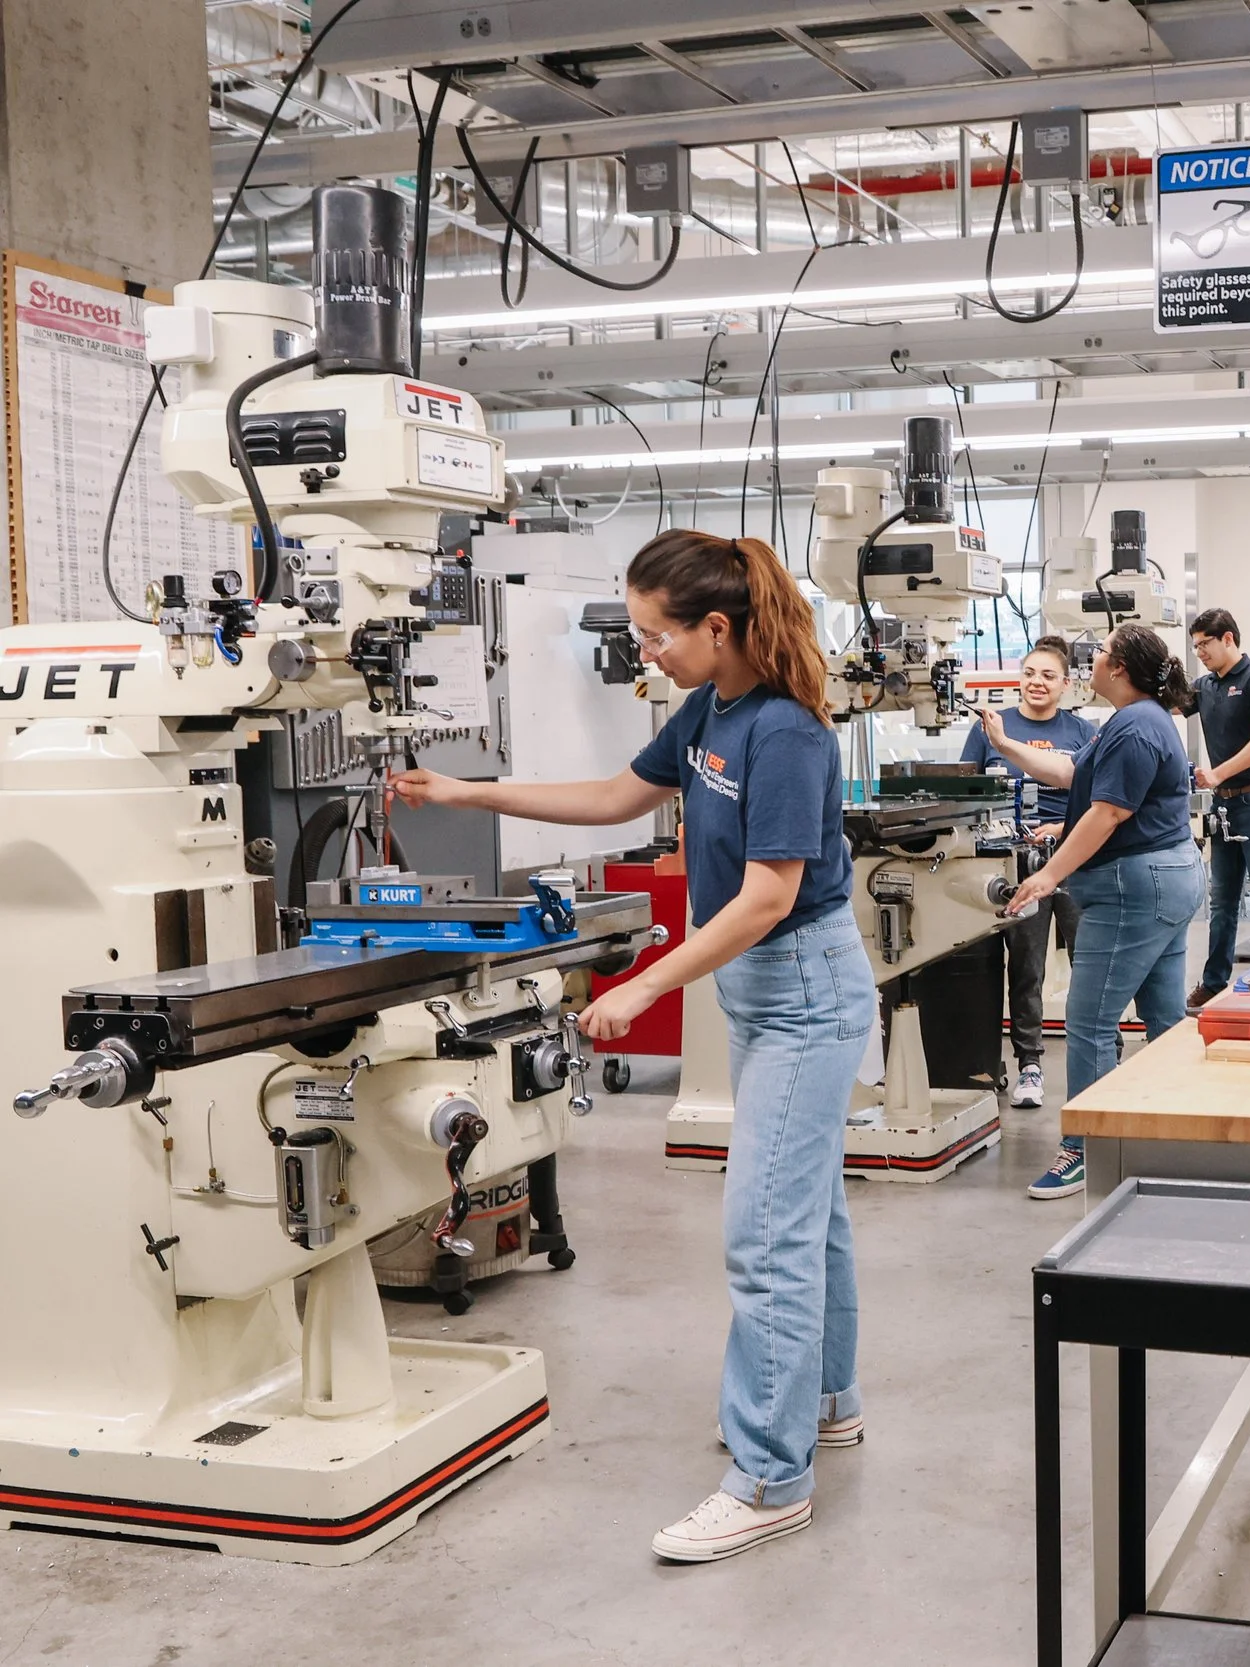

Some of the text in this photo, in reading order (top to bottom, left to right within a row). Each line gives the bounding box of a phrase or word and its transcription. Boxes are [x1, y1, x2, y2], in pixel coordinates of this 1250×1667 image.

[1162, 275, 1203, 290] Safety
[29, 280, 122, 327] Starrett
[330, 293, 354, 302] Power
[1162, 288, 1218, 305] required
[1162, 302, 1228, 319] this point.
[86, 338, 101, 351] TAP
[102, 342, 123, 357] DRILL
[124, 347, 144, 361] SIZES
[407, 395, 463, 424] JET
[962, 533, 984, 551] JET
[0, 663, 136, 700] JET
[965, 688, 1022, 704] JET
[201, 797, 226, 822] M
[380, 888, 417, 902] KURT
[469, 1175, 529, 1212] RIDGI
